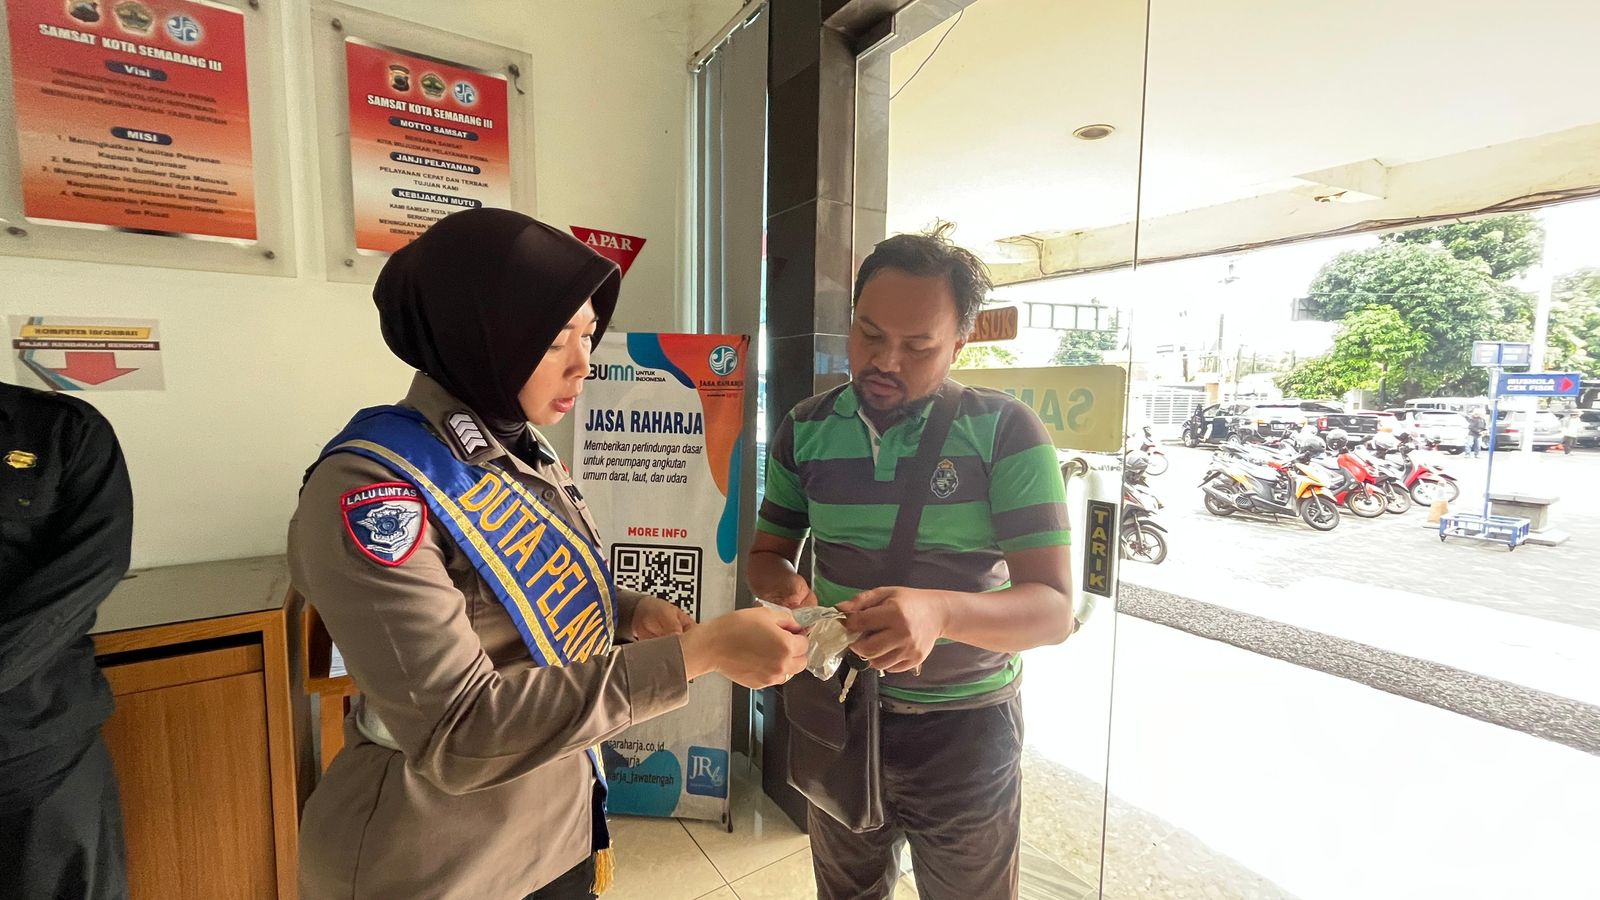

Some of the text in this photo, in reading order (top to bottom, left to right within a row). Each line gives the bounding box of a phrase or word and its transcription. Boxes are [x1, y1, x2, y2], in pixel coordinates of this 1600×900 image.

[39, 24, 224, 72] SAMSAT KOTA SEMARANG III
[124, 65, 151, 78] Visi
[367, 94, 493, 129] SAMSAT KOTA SEMARANG III
[127, 128, 158, 143] MISI
[400, 119, 468, 139] MOTTO SAMSAT
[138, 147, 174, 158] Kualitas
[176, 152, 221, 164] Pelayanan
[396, 153, 475, 173] JANJI PELAYANAN
[132, 167, 167, 177] Sumber
[169, 172, 191, 181] Daya
[193, 175, 228, 186] Manusia
[379, 166, 489, 188] PELAYANAN CEPAT DAN TERBAIK
[413, 179, 459, 192] TUJUAN KAMI
[175, 183, 192, 191] dan
[398, 190, 475, 208] KEBIJAKAN MUTU
[406, 205, 430, 213] SAMSAT
[586, 232, 633, 251] APAR
[35, 328, 87, 336] KOMPUTER
[585, 409, 703, 435] JASA RAHARJA
[583, 440, 703, 456] Memberikan perlindungan dasar
[583, 455, 686, 470] untuk penumpang angkutan
[583, 471, 687, 484] umum darat, laut, dan udara
[346, 486, 417, 505] LALU LINTAS
[458, 472, 546, 572] DUTA
[627, 526, 687, 539] MORE INFO
[1089, 509, 1108, 589] TARIK
